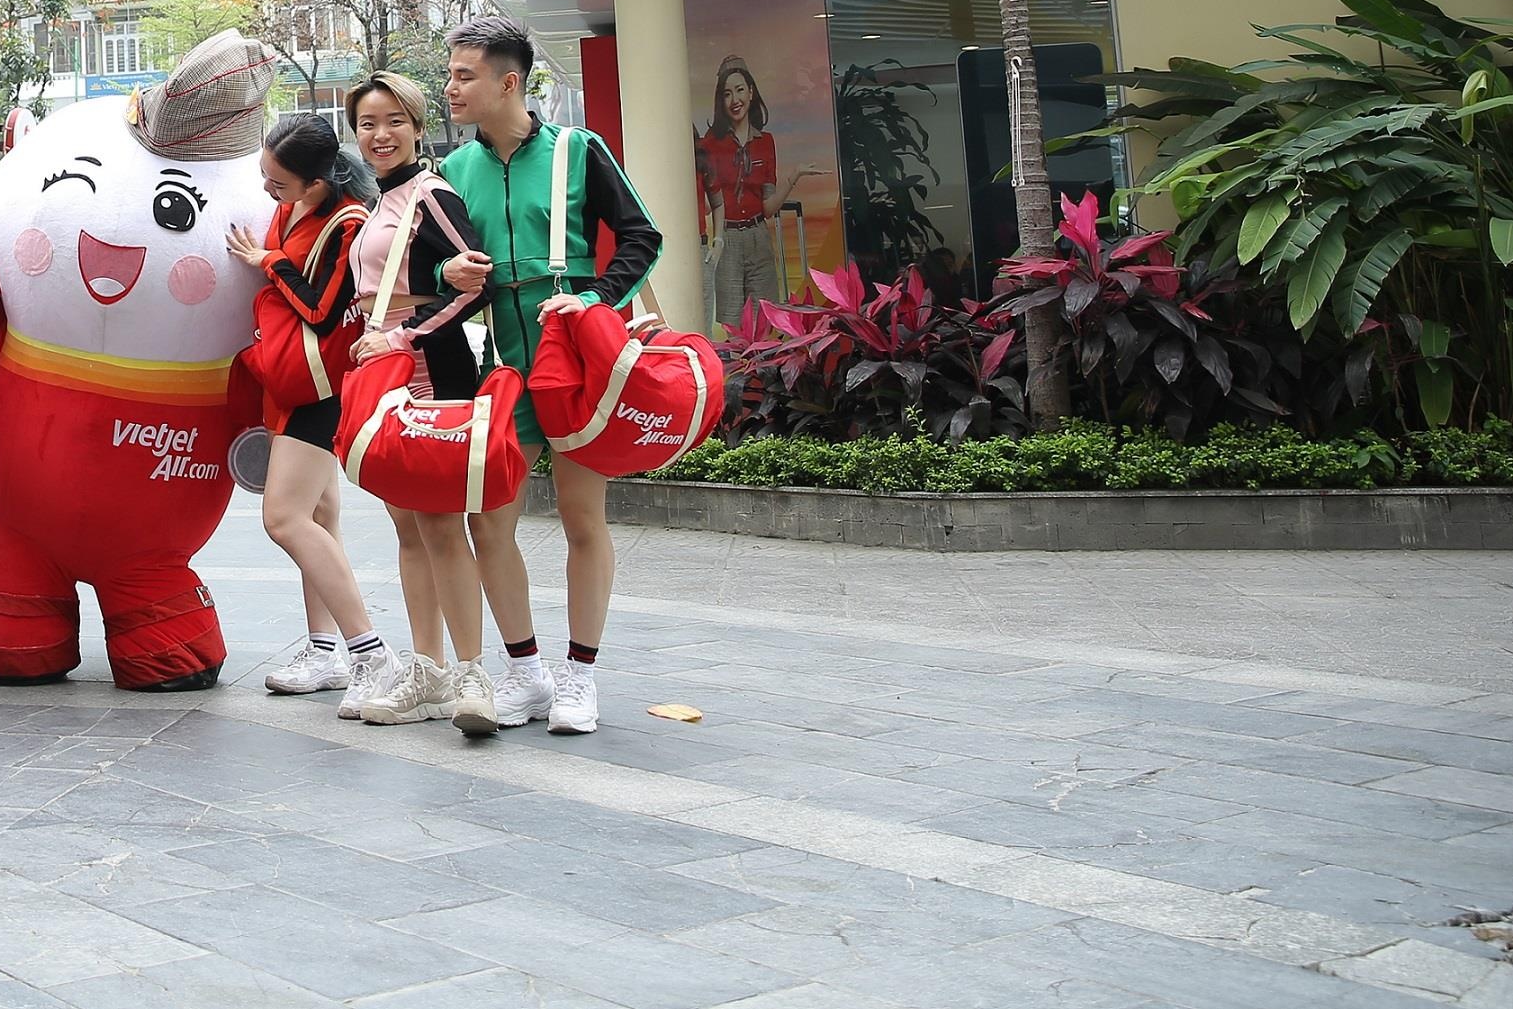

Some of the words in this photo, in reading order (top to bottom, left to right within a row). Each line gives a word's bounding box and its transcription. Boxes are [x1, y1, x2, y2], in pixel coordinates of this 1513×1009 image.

[616, 402, 673, 432] Vietjet
[112, 419, 199, 457] Vietjet
[633, 430, 685, 446] Air.com
[149, 454, 220, 482] Air.com
